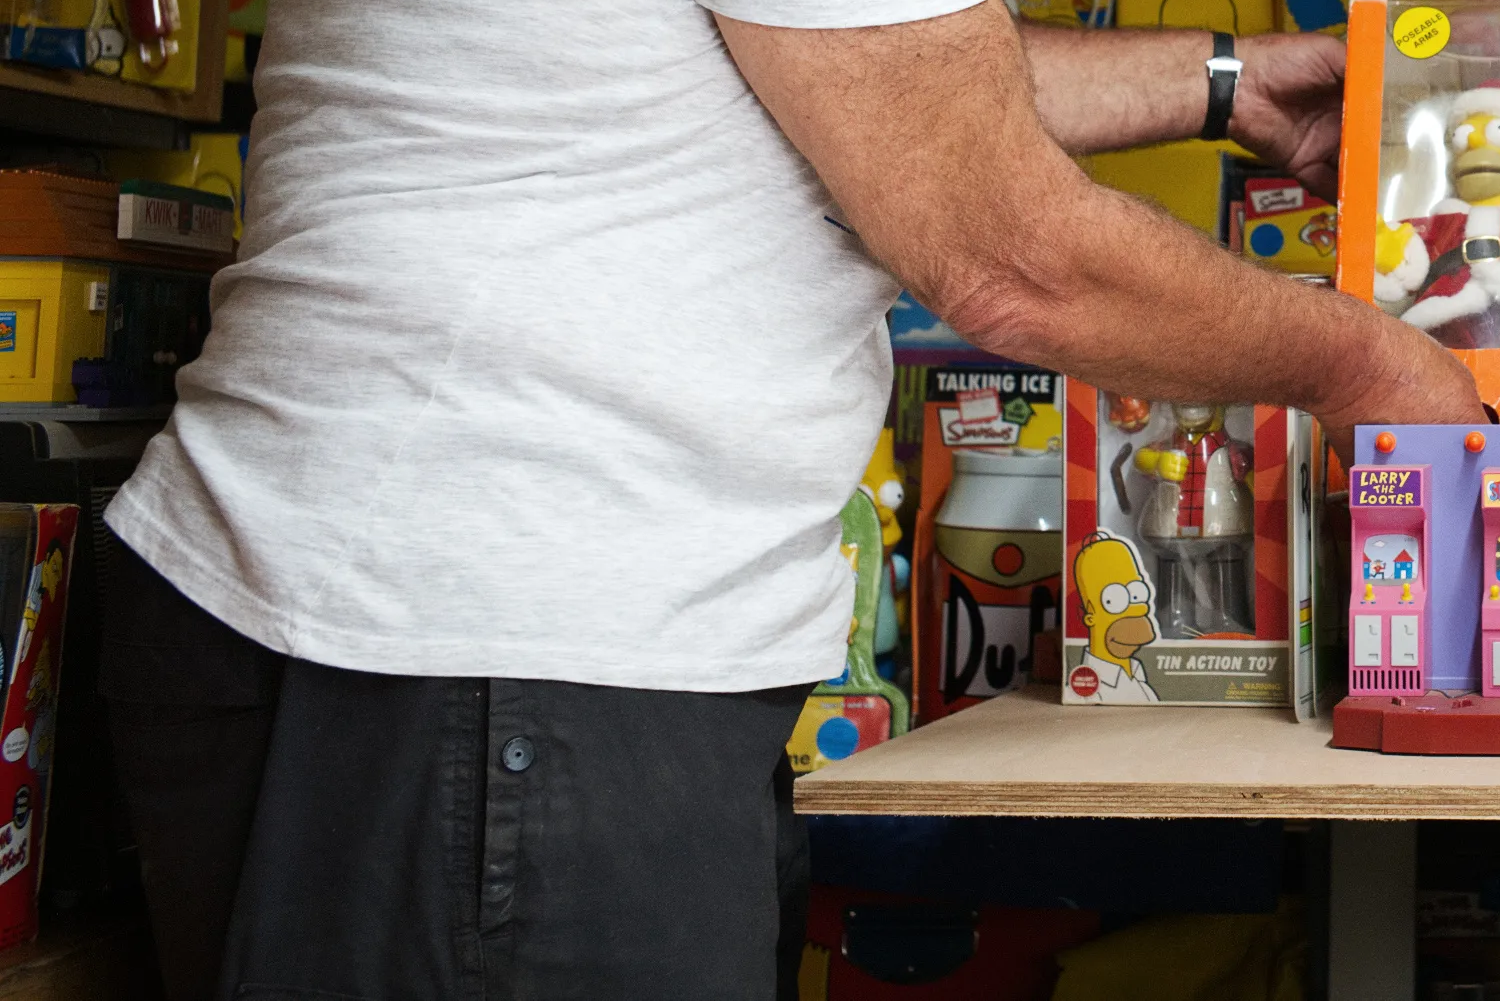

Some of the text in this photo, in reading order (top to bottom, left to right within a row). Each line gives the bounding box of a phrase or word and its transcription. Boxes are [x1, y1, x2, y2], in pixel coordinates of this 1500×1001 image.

[1396, 12, 1443, 47] POSEABLE
[1413, 27, 1439, 49] ARMS
[936, 371, 1050, 394] TALKING ICE
[1359, 471, 1411, 487] LARRY
[1373, 484, 1396, 494] THE
[1359, 490, 1415, 505] LOOTER
[1156, 655, 1280, 671] TIN ACTION TOY
